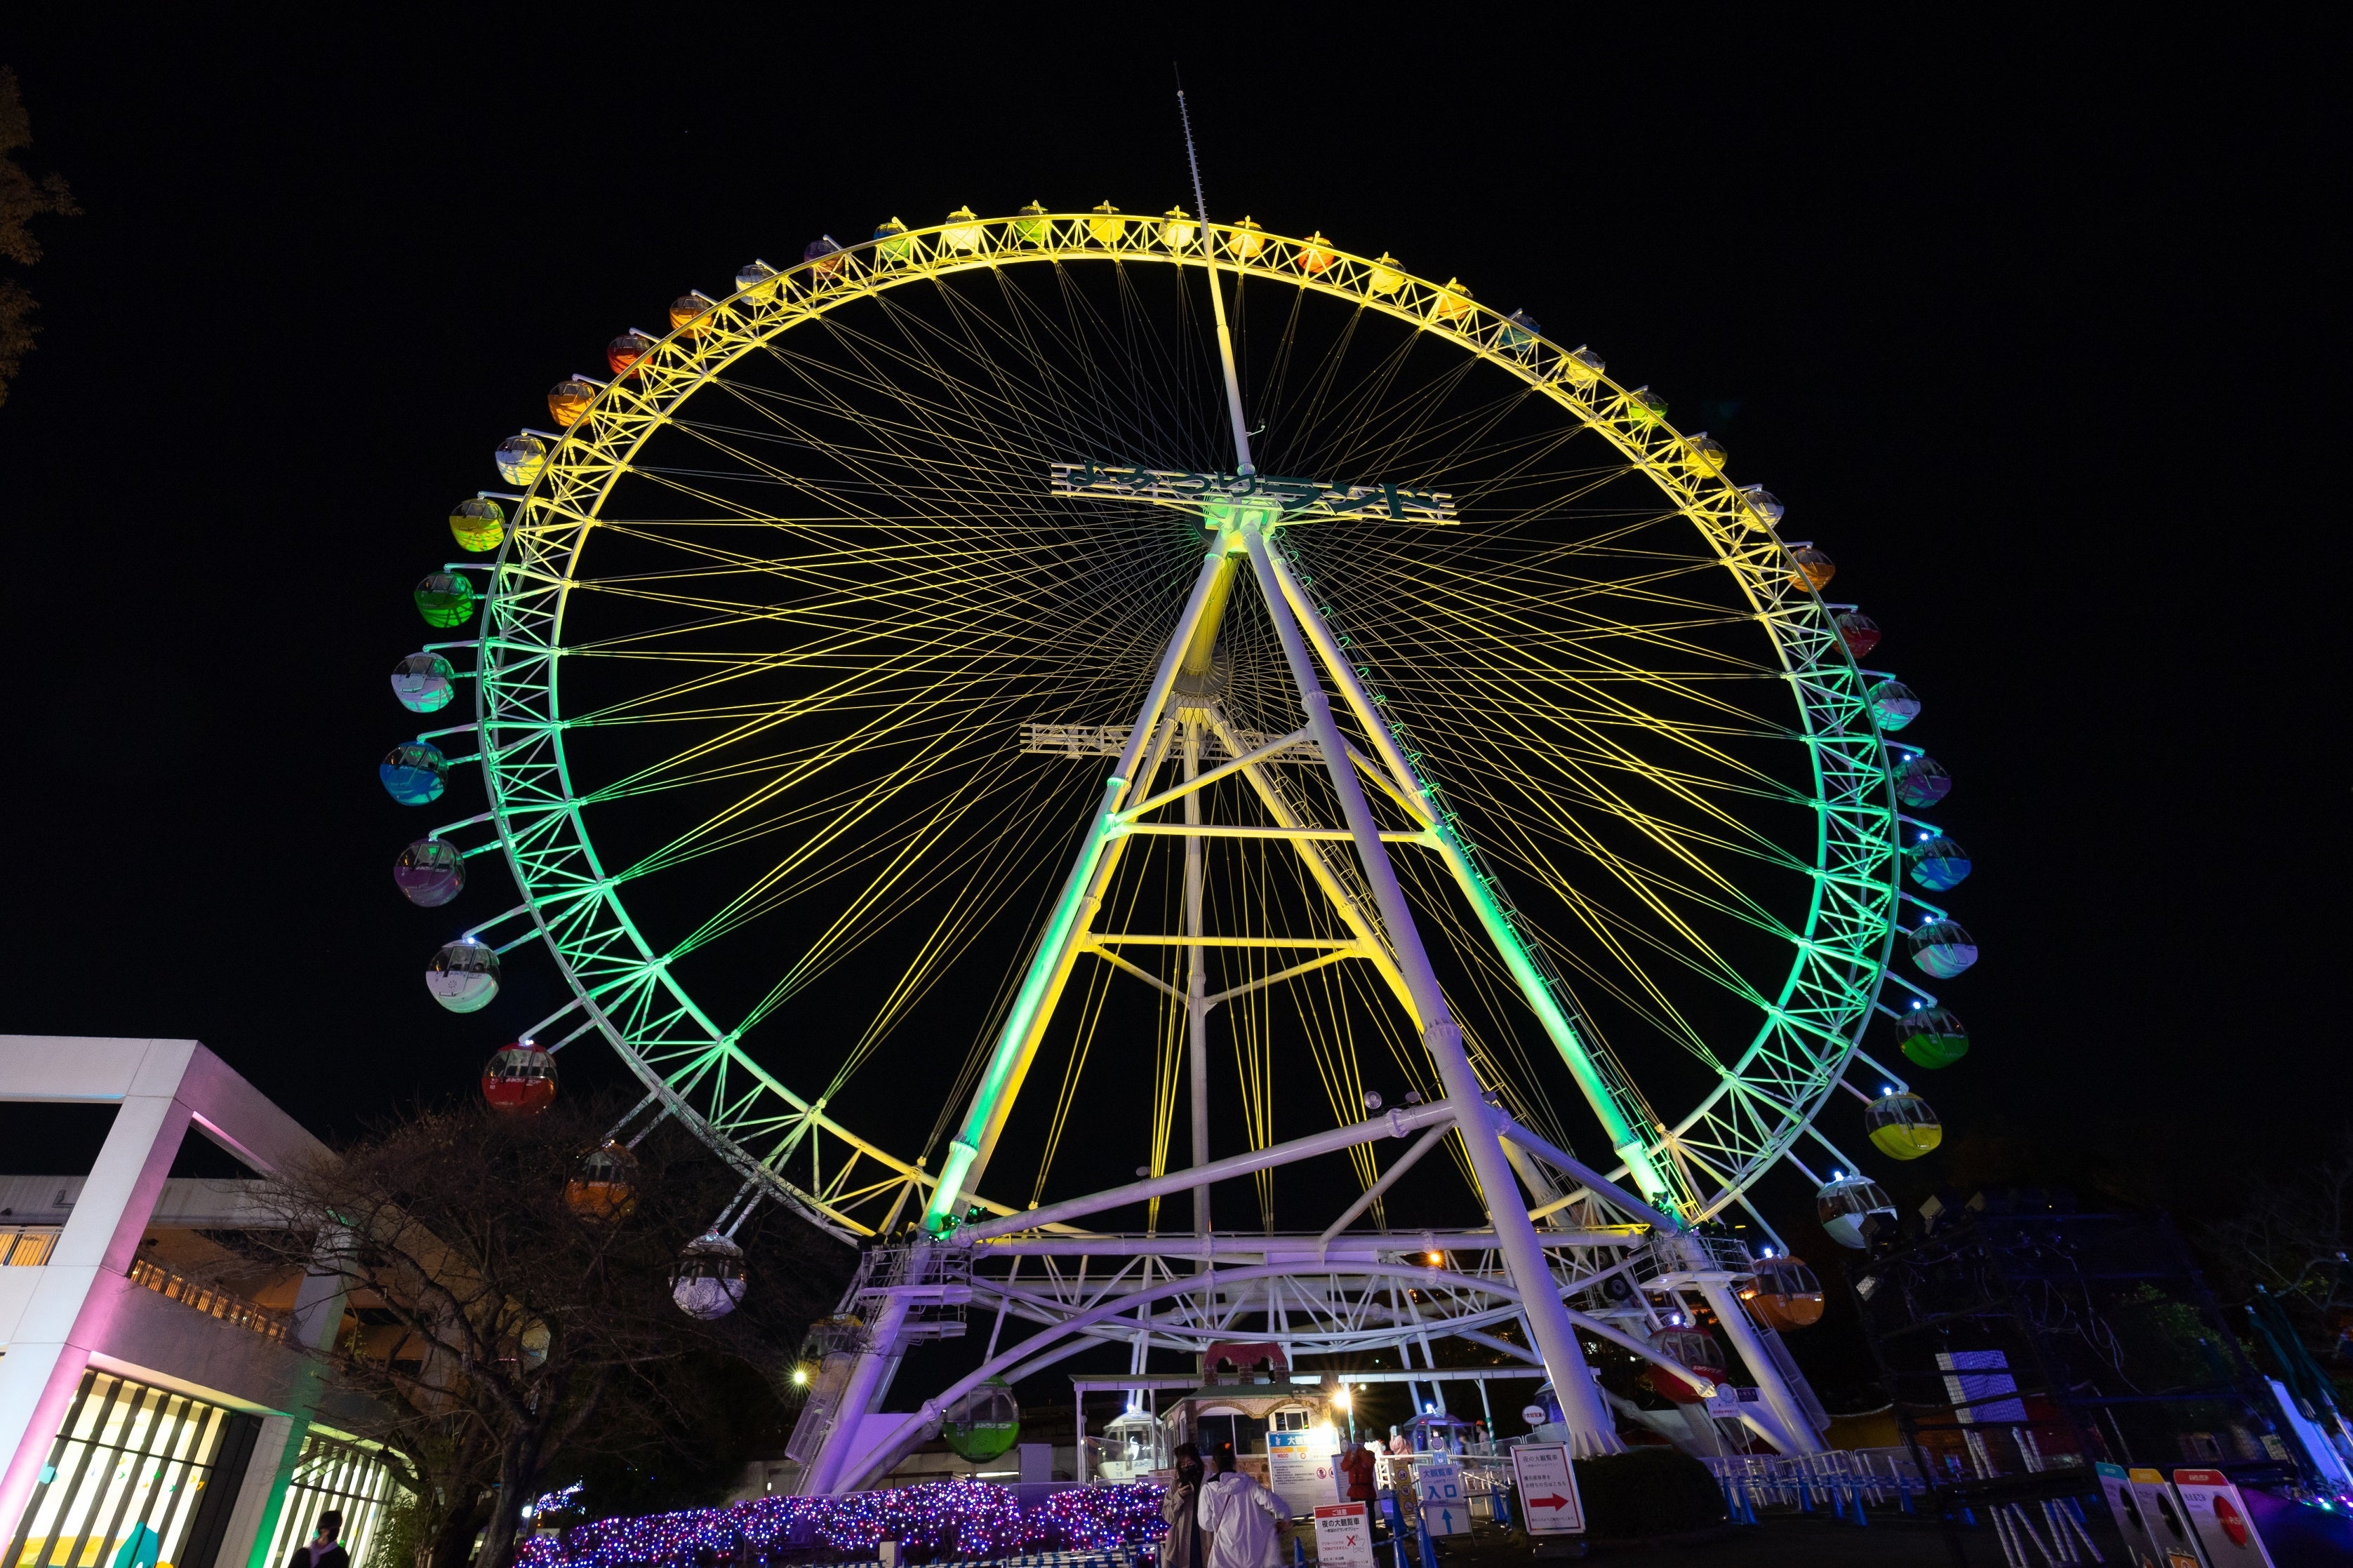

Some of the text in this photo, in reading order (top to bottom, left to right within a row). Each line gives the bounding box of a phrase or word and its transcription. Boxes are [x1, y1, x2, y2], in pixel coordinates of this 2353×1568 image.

[1065, 460, 1441, 521] よみうりランド
[1428, 1484, 1457, 1500] 入口
[1321, 1517, 1360, 1528] 夜の大観覧車
